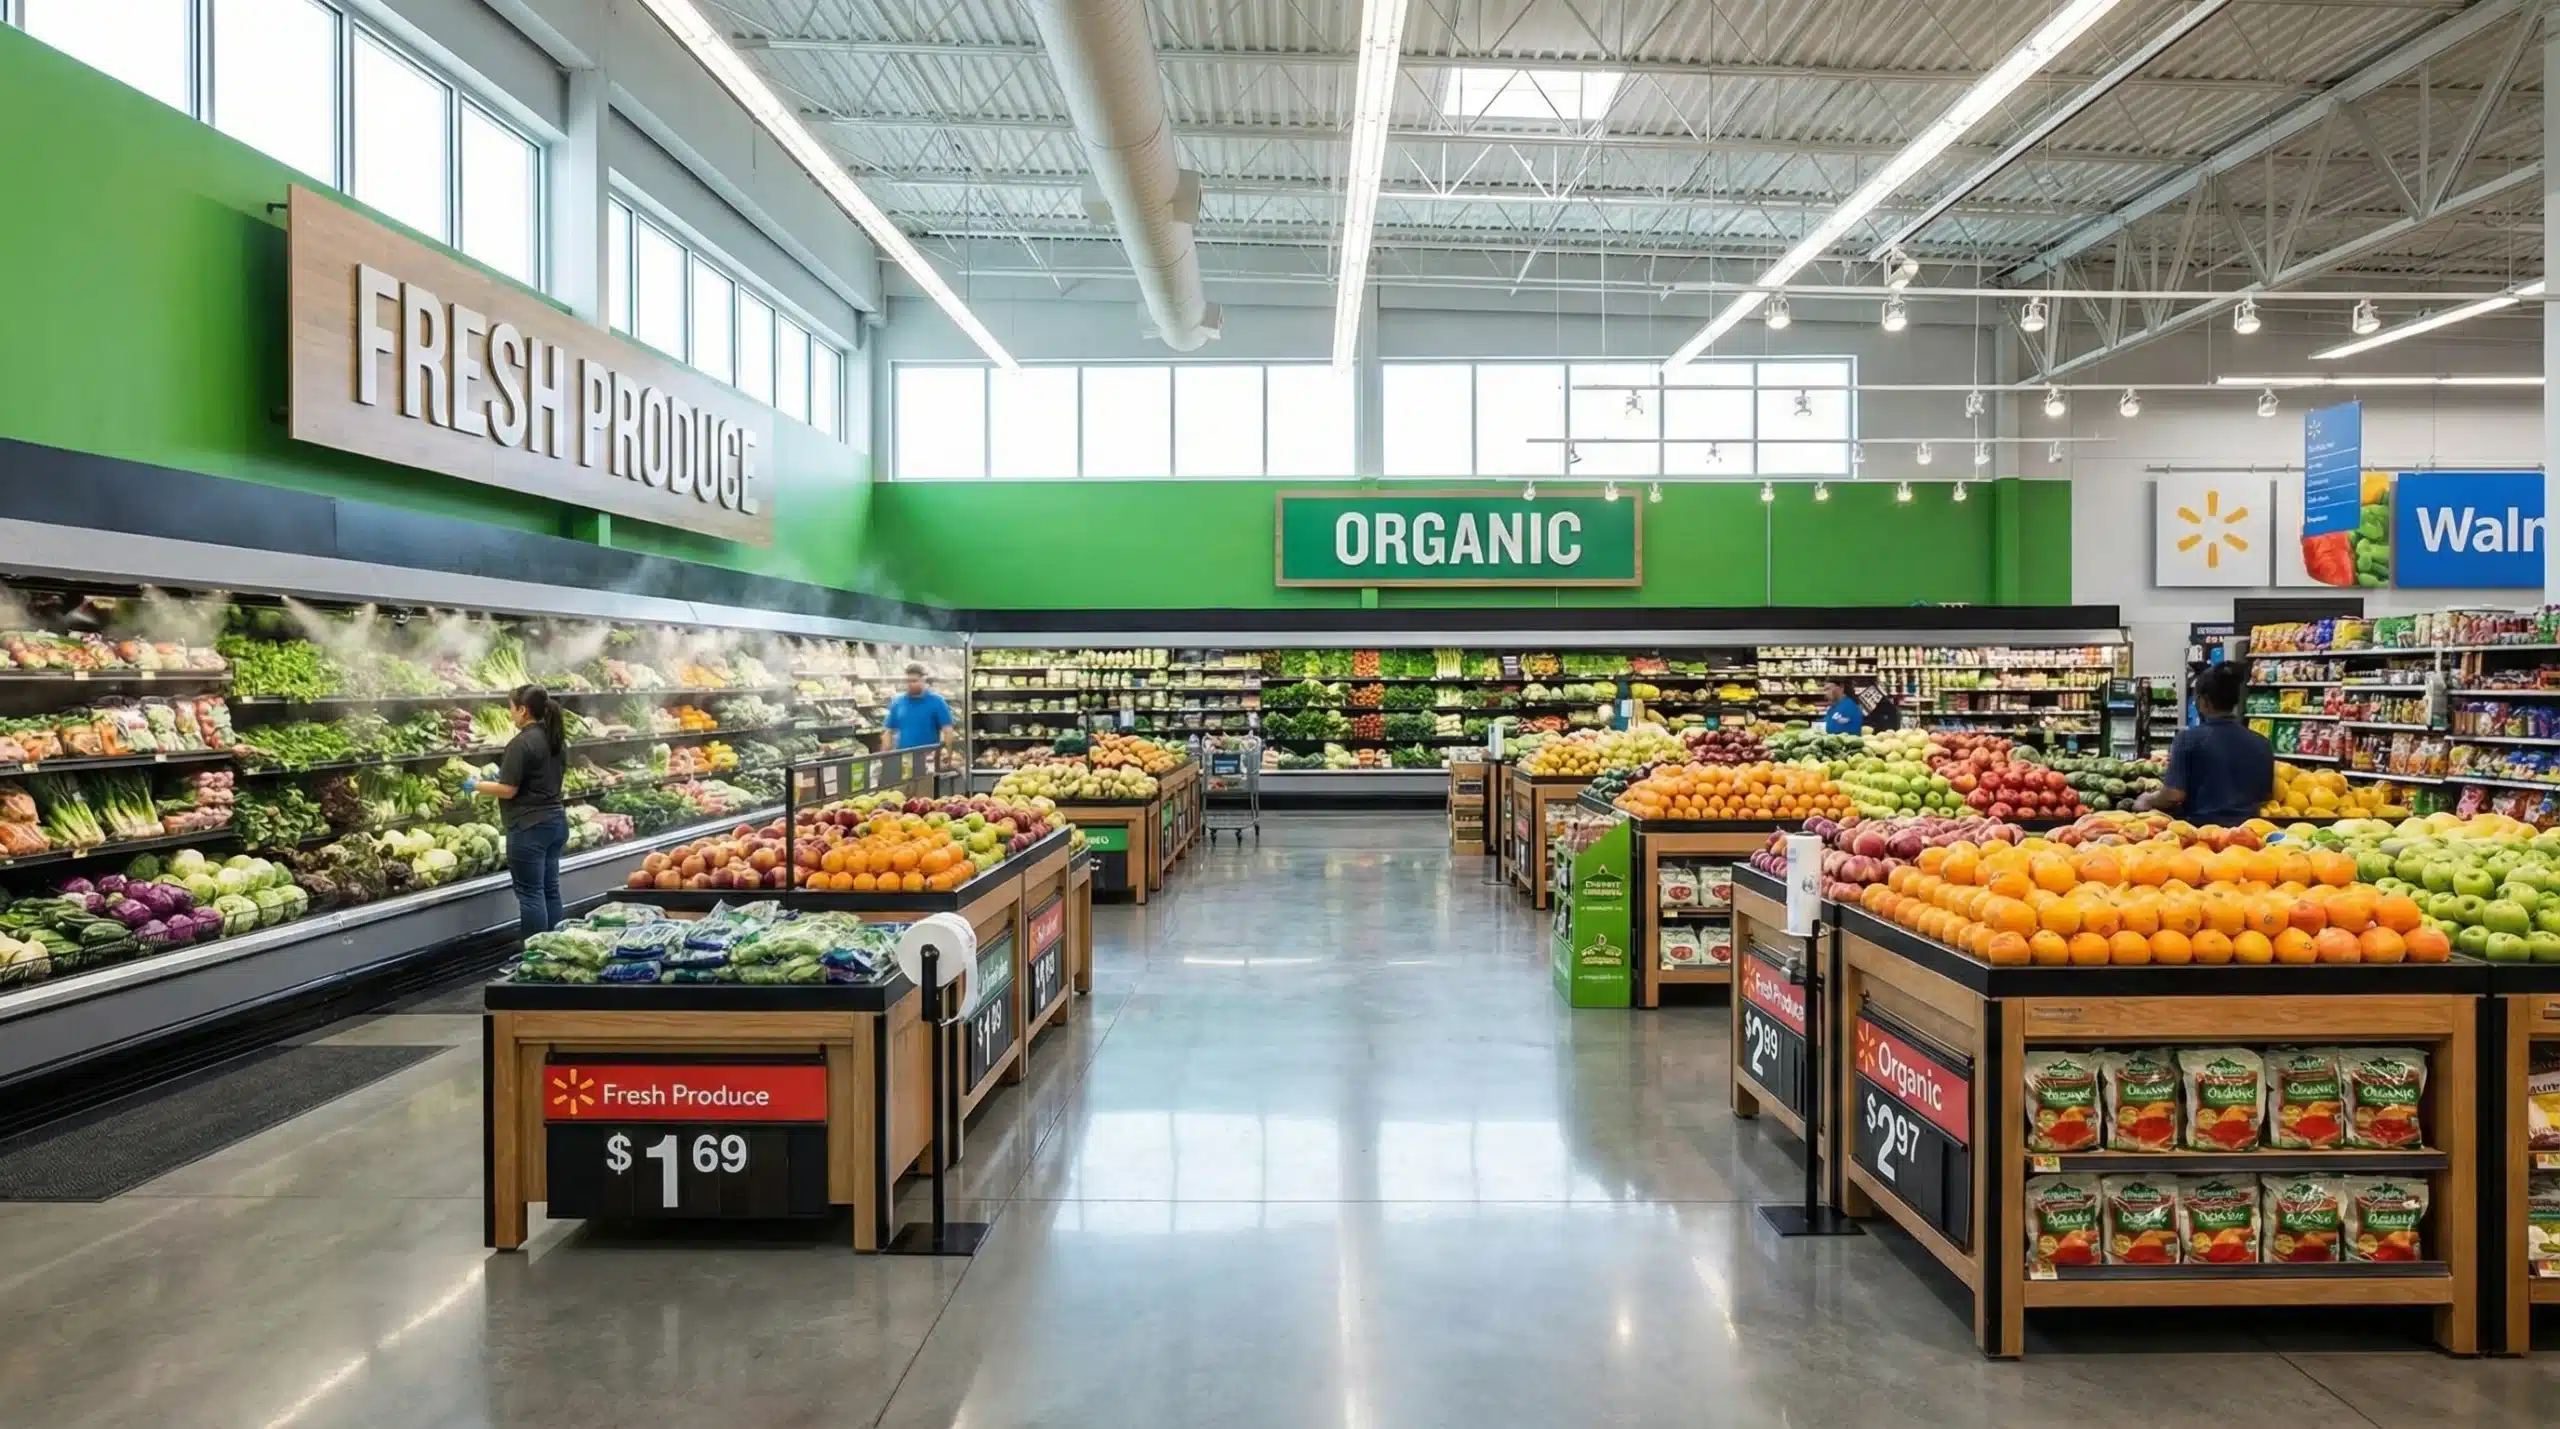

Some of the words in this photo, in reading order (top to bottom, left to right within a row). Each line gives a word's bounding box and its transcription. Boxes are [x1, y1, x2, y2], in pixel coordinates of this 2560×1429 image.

[356, 262, 566, 460] FRESH
[579, 357, 760, 516] PRODUCE
[1335, 510, 1582, 567] ORGANIC
[603, 1084, 666, 1106] Fresh
[672, 1084, 770, 1107] Produce
[1878, 1041, 1943, 1111] Organic
